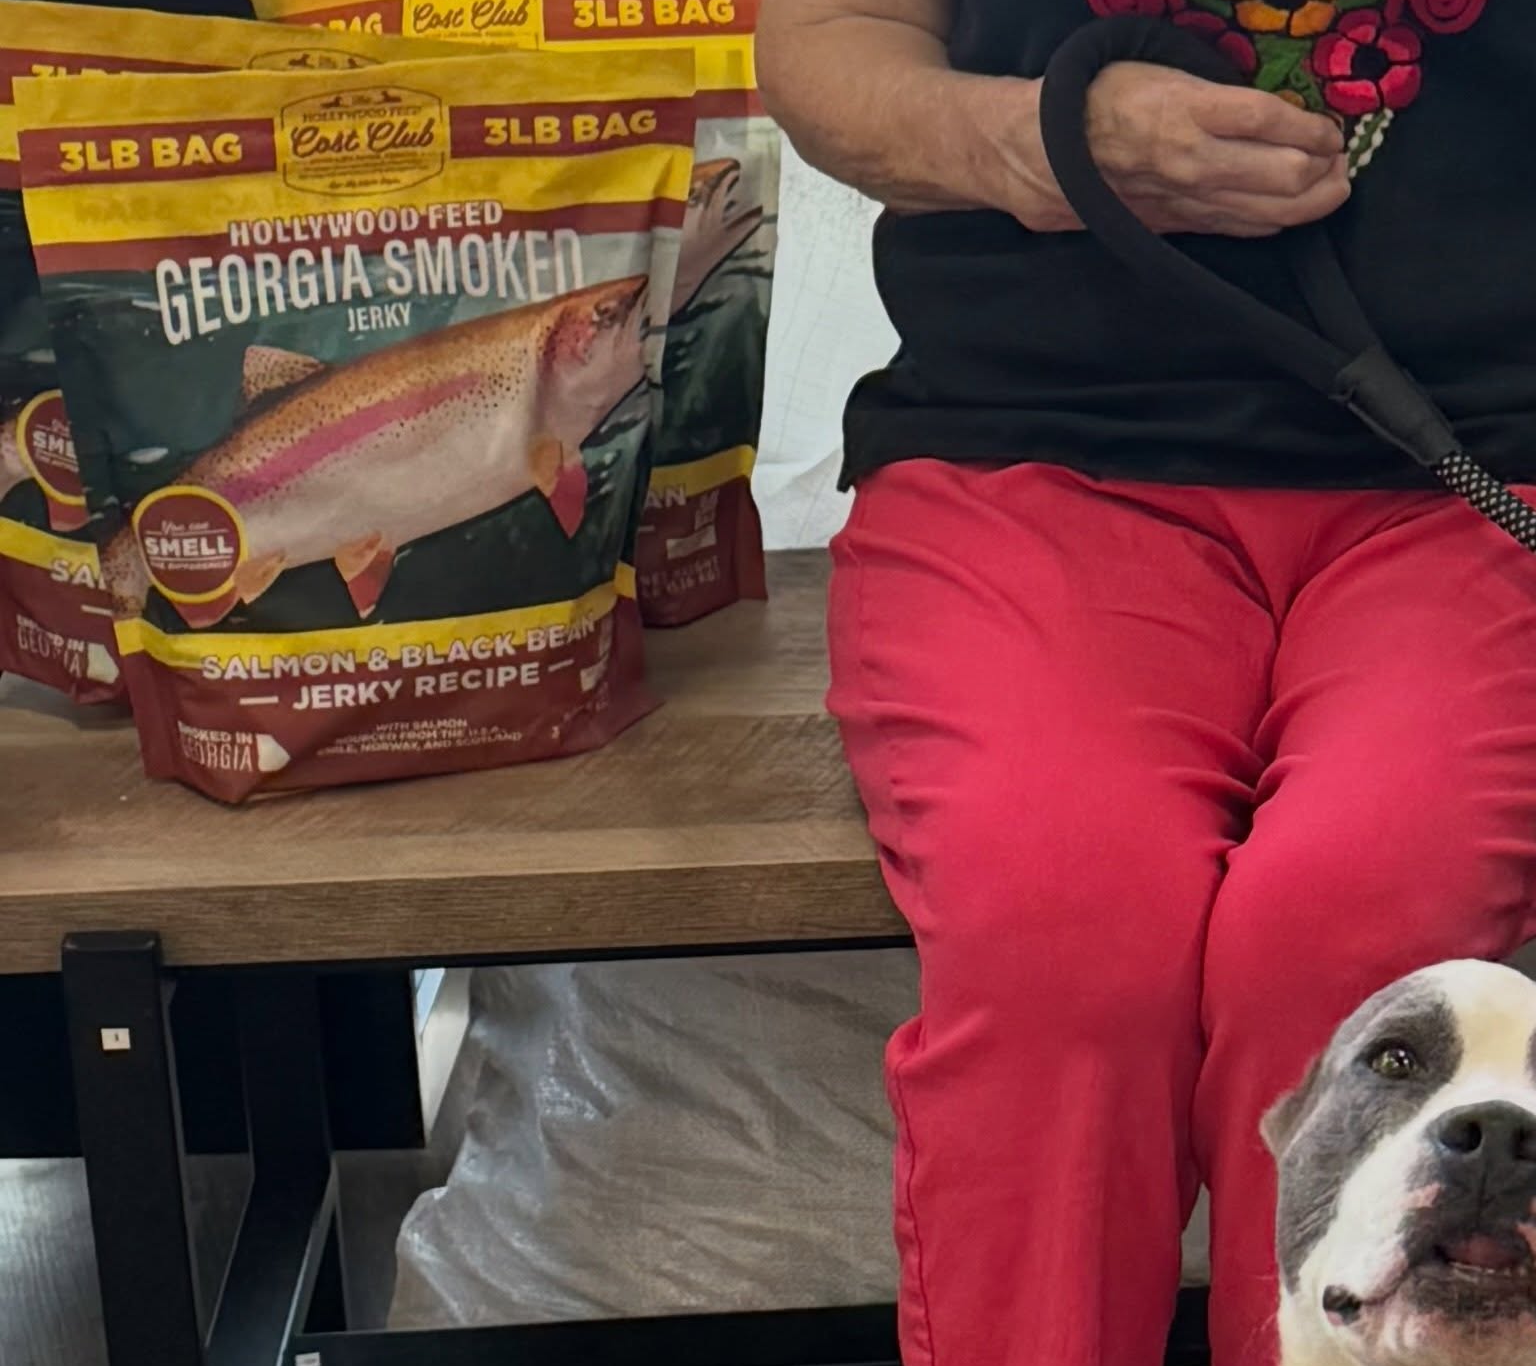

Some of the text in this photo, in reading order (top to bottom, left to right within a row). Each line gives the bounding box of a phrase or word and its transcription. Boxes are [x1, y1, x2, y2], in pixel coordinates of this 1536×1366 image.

[412, 2, 465, 34] Cost
[290, 117, 436, 159] Cost Club
[483, 109, 658, 147] 3LB BAG
[58, 132, 243, 173] 3LB BAG
[228, 200, 504, 247] HOLLYWOOD FEED
[155, 227, 584, 346] GEORGIA SMOKED
[347, 301, 412, 333] JERKY
[143, 535, 235, 557] SMELL
[200, 614, 597, 682] SALMON & BLACK BEAN
[291, 660, 542, 712] JERKY RECIPE
[235, 730, 254, 745] IN
[412, 717, 468, 732] SALMON
[423, 737, 451, 750] AND
